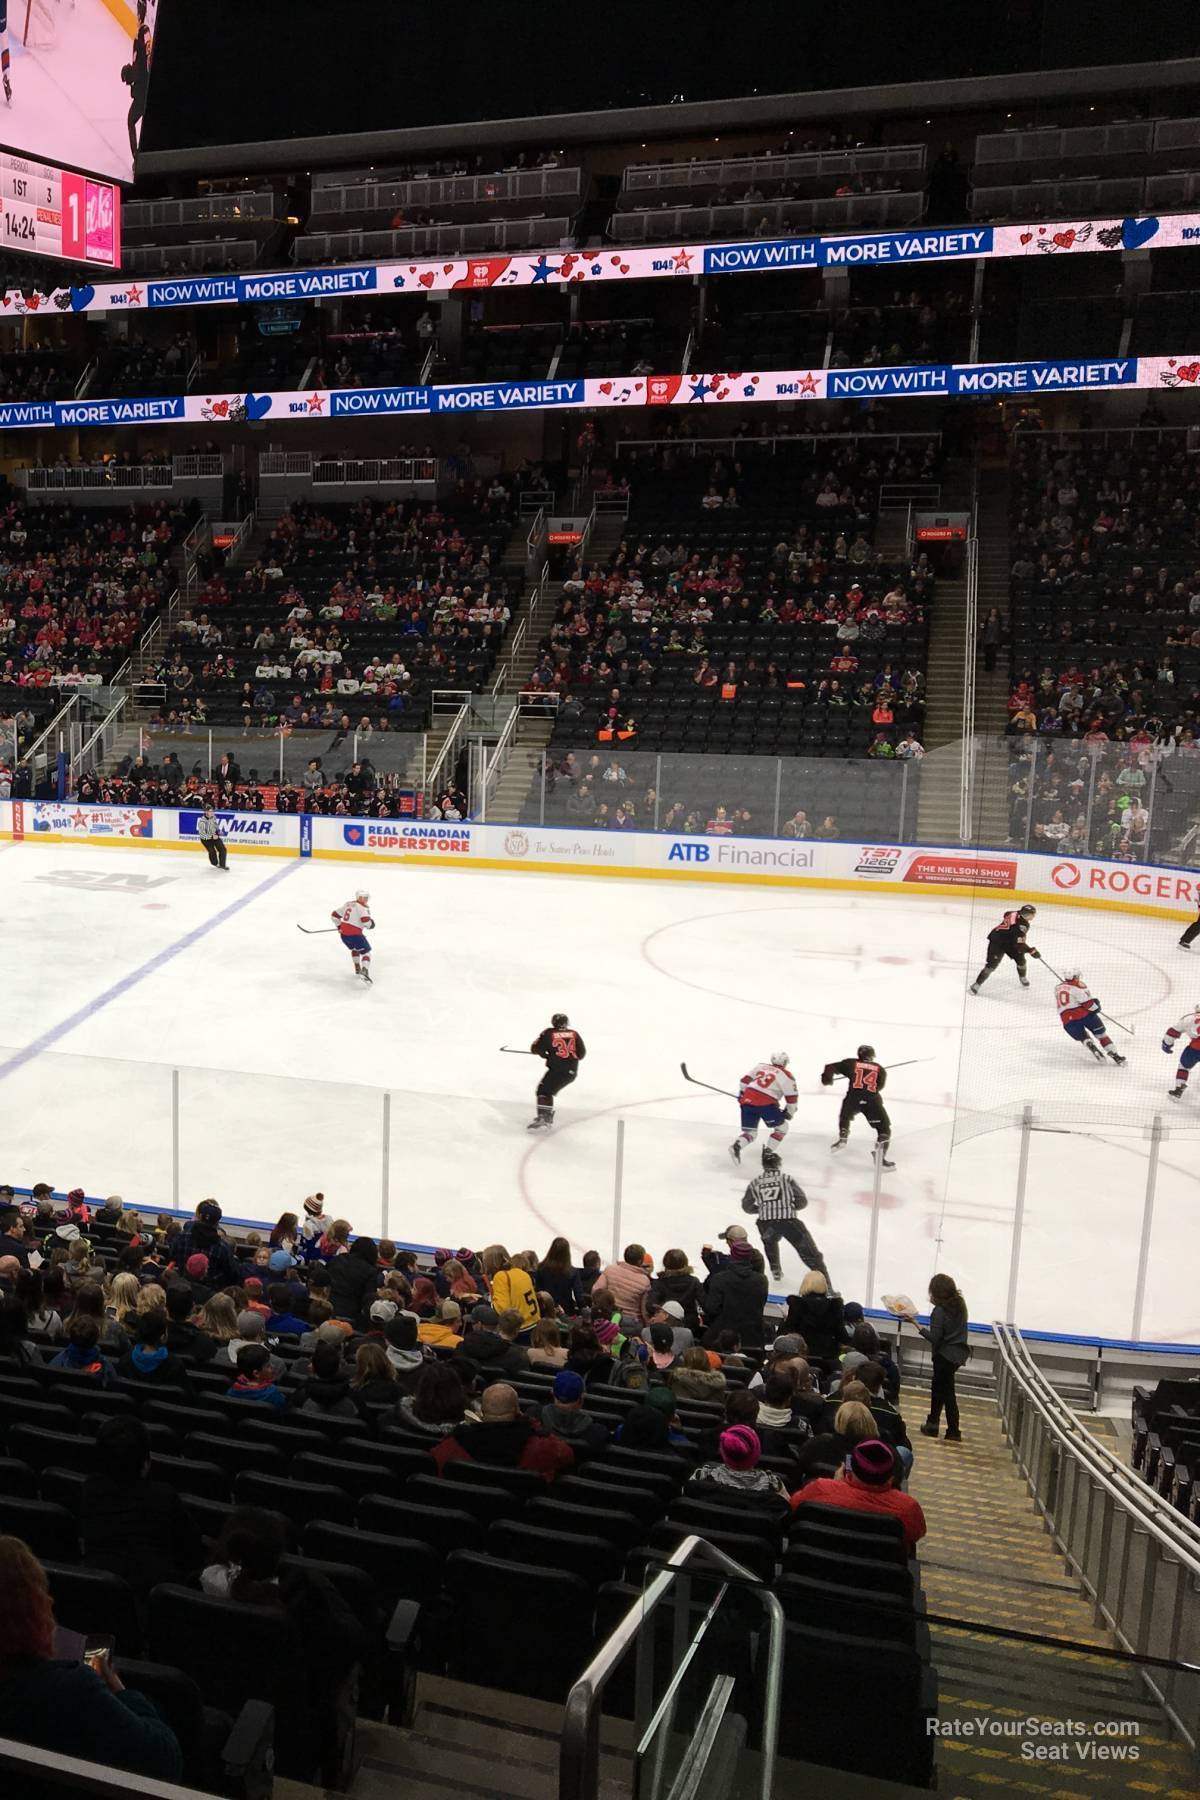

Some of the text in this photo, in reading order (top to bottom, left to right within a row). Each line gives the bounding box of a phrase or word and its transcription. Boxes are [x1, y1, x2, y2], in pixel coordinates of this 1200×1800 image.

[13, 178, 27, 197] 1ST
[46, 188, 52, 203] 3
[6, 213, 35, 240] 14:24
[69, 192, 78, 242] 1
[710, 232, 984, 268] NOW WITH MORE VARIETY
[153, 271, 369, 302] NOW WITH MORE VARIETY
[833, 362, 1128, 394] NOW WITH MORE VARIETY
[336, 384, 577, 411] NOW WITH MORE VARIETY
[12, 406, 52, 422] WITH
[62, 406, 110, 423] MORE
[112, 401, 178, 420] VARIETY
[196, 817, 272, 836] NMAR
[368, 826, 471, 840] REAL CANADIAN
[368, 836, 470, 852] SUPERSTORE
[668, 842, 814, 868] ATB Financial
[862, 847, 902, 858] TSN
[864, 858, 898, 867] 1260
[917, 865, 1010, 878] THE NIELSON SHOW
[552, 1038, 578, 1060] 34
[853, 1068, 878, 1092] 14
[524, 1290, 538, 1316] 5
